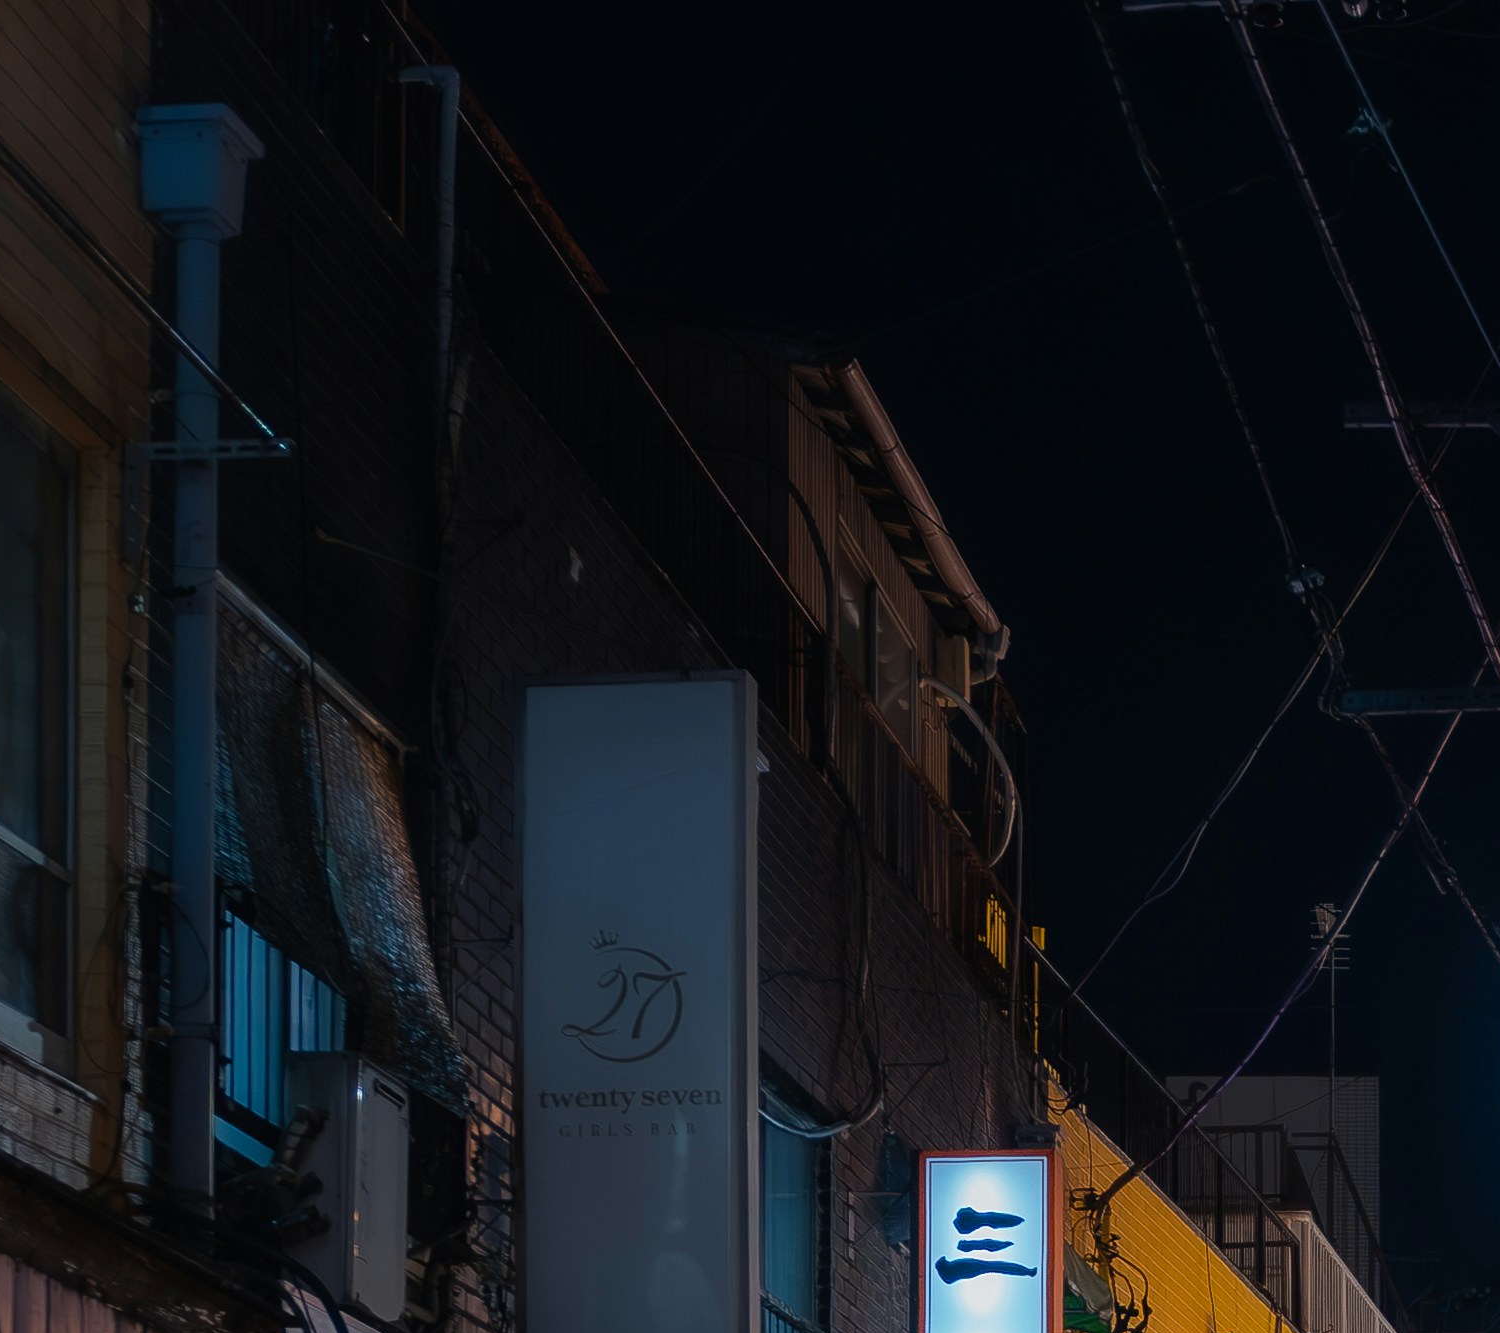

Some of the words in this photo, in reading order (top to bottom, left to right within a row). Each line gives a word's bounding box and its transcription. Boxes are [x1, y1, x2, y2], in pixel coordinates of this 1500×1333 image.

[560, 963, 688, 1040] 27
[539, 1085, 637, 1116] twenty
[641, 1083, 722, 1108] seven
[557, 1121, 636, 1139] GIRLS
[650, 1120, 697, 1137] BAR
